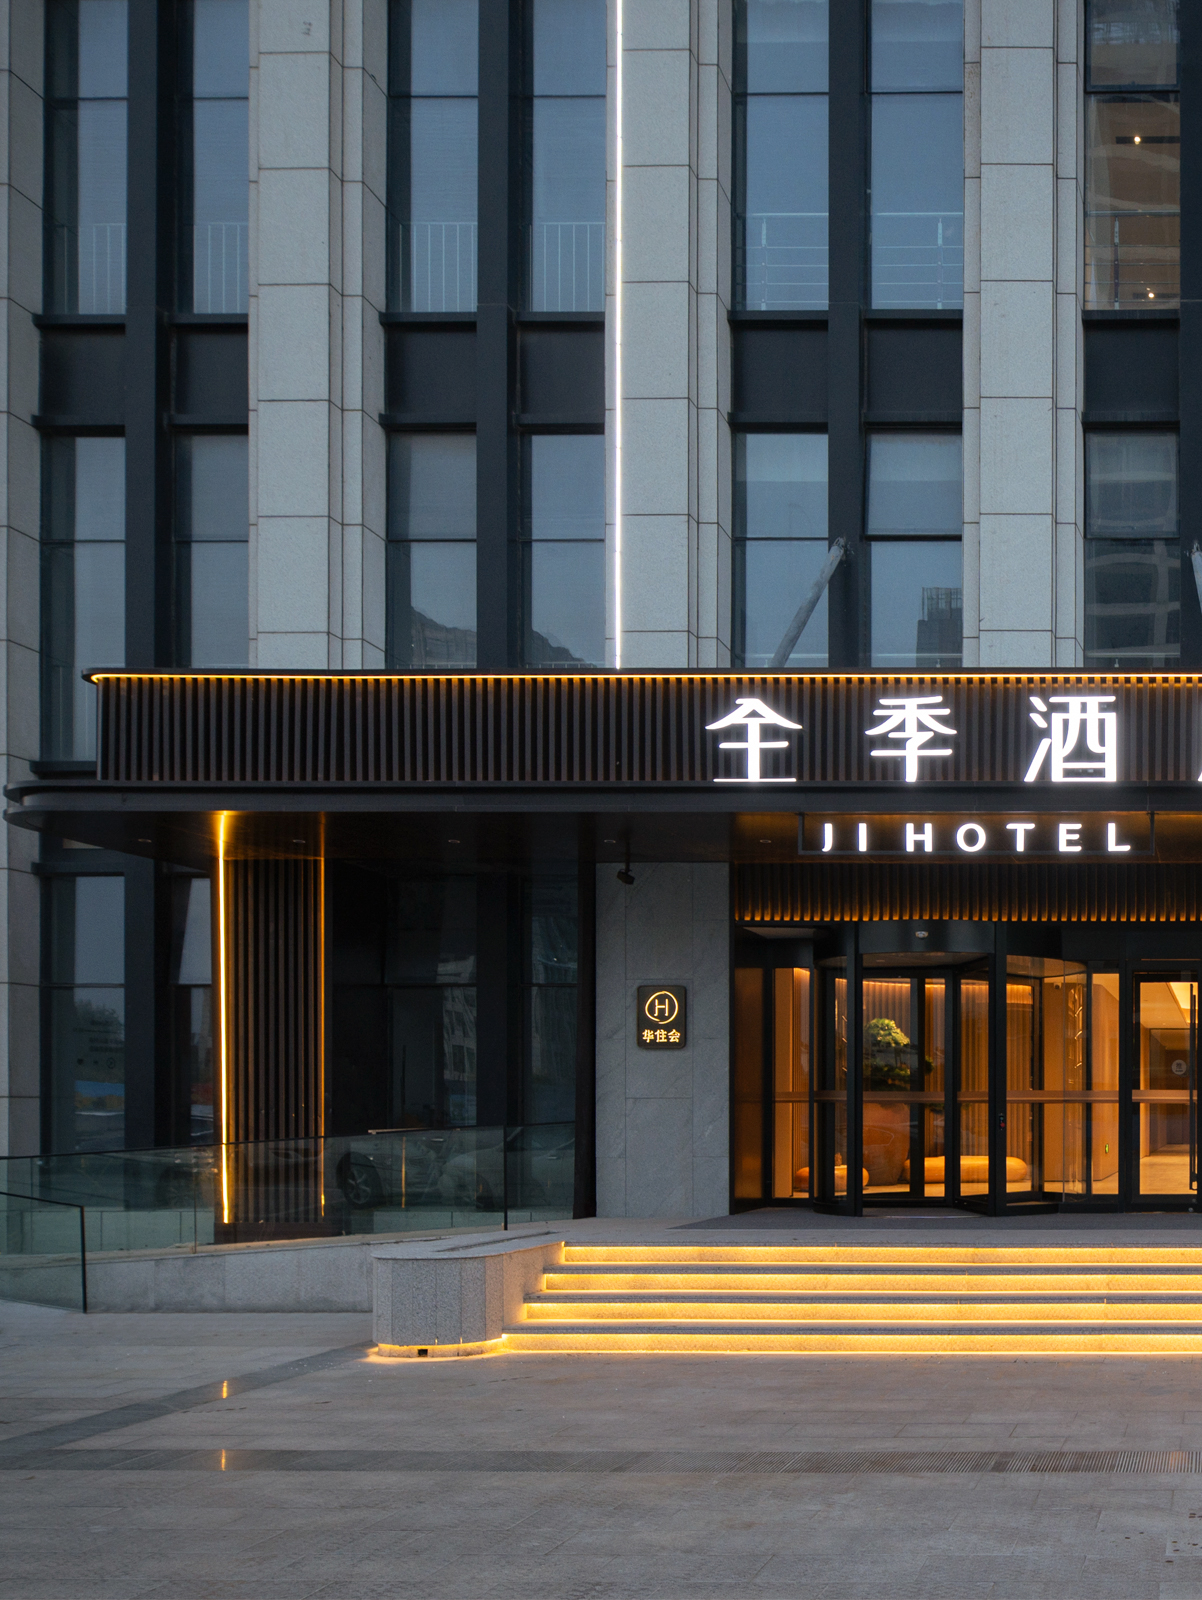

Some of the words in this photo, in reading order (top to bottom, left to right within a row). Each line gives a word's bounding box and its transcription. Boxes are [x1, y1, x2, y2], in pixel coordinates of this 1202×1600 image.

[821, 822, 868, 853] JI
[905, 822, 1131, 853] HOTEL
[653, 998, 669, 1017] H
[641, 1028, 681, 1043] 华住会
